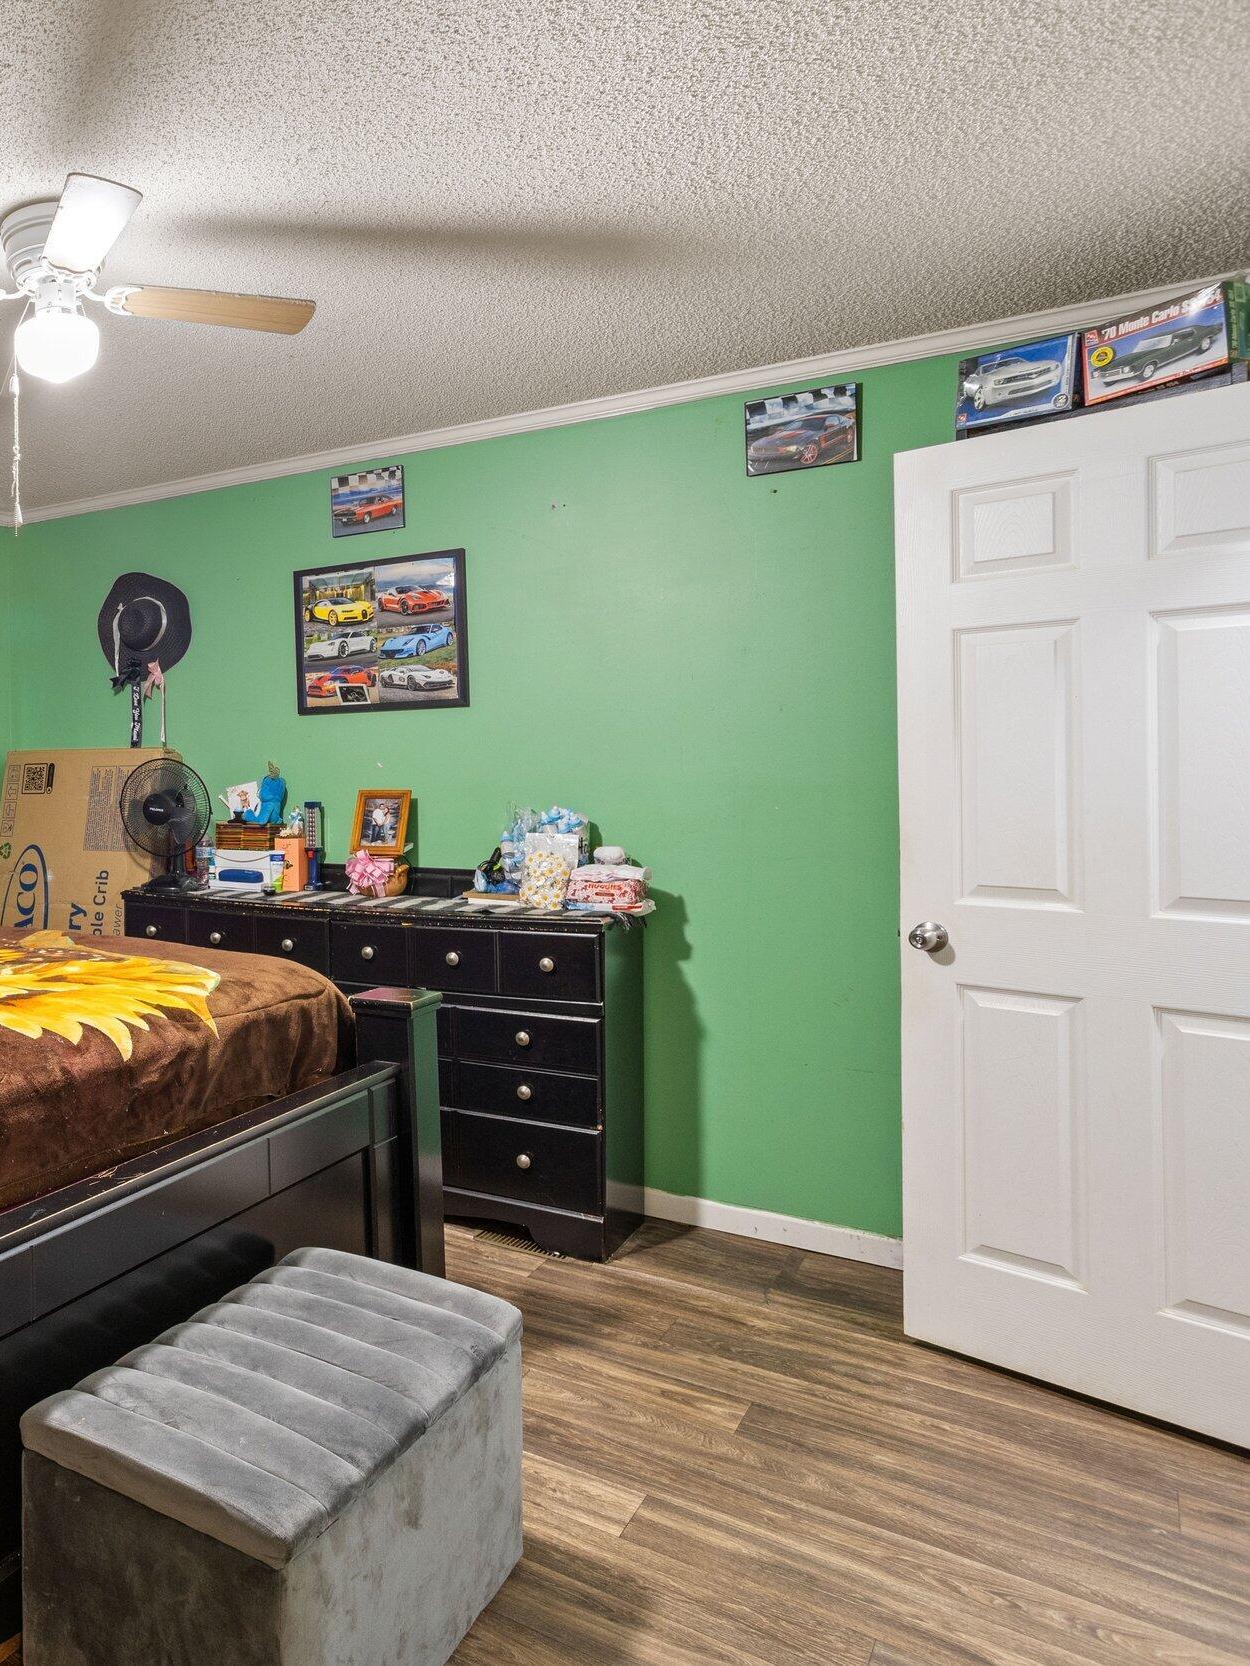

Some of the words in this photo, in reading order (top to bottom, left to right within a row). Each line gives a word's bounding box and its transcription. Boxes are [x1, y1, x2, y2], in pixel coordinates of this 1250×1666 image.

[1118, 315, 1150, 335] Monte
[1152, 305, 1180, 324] Carlo
[93, 870, 110, 905] Crib
[588, 883, 623, 891] HUGGIES
